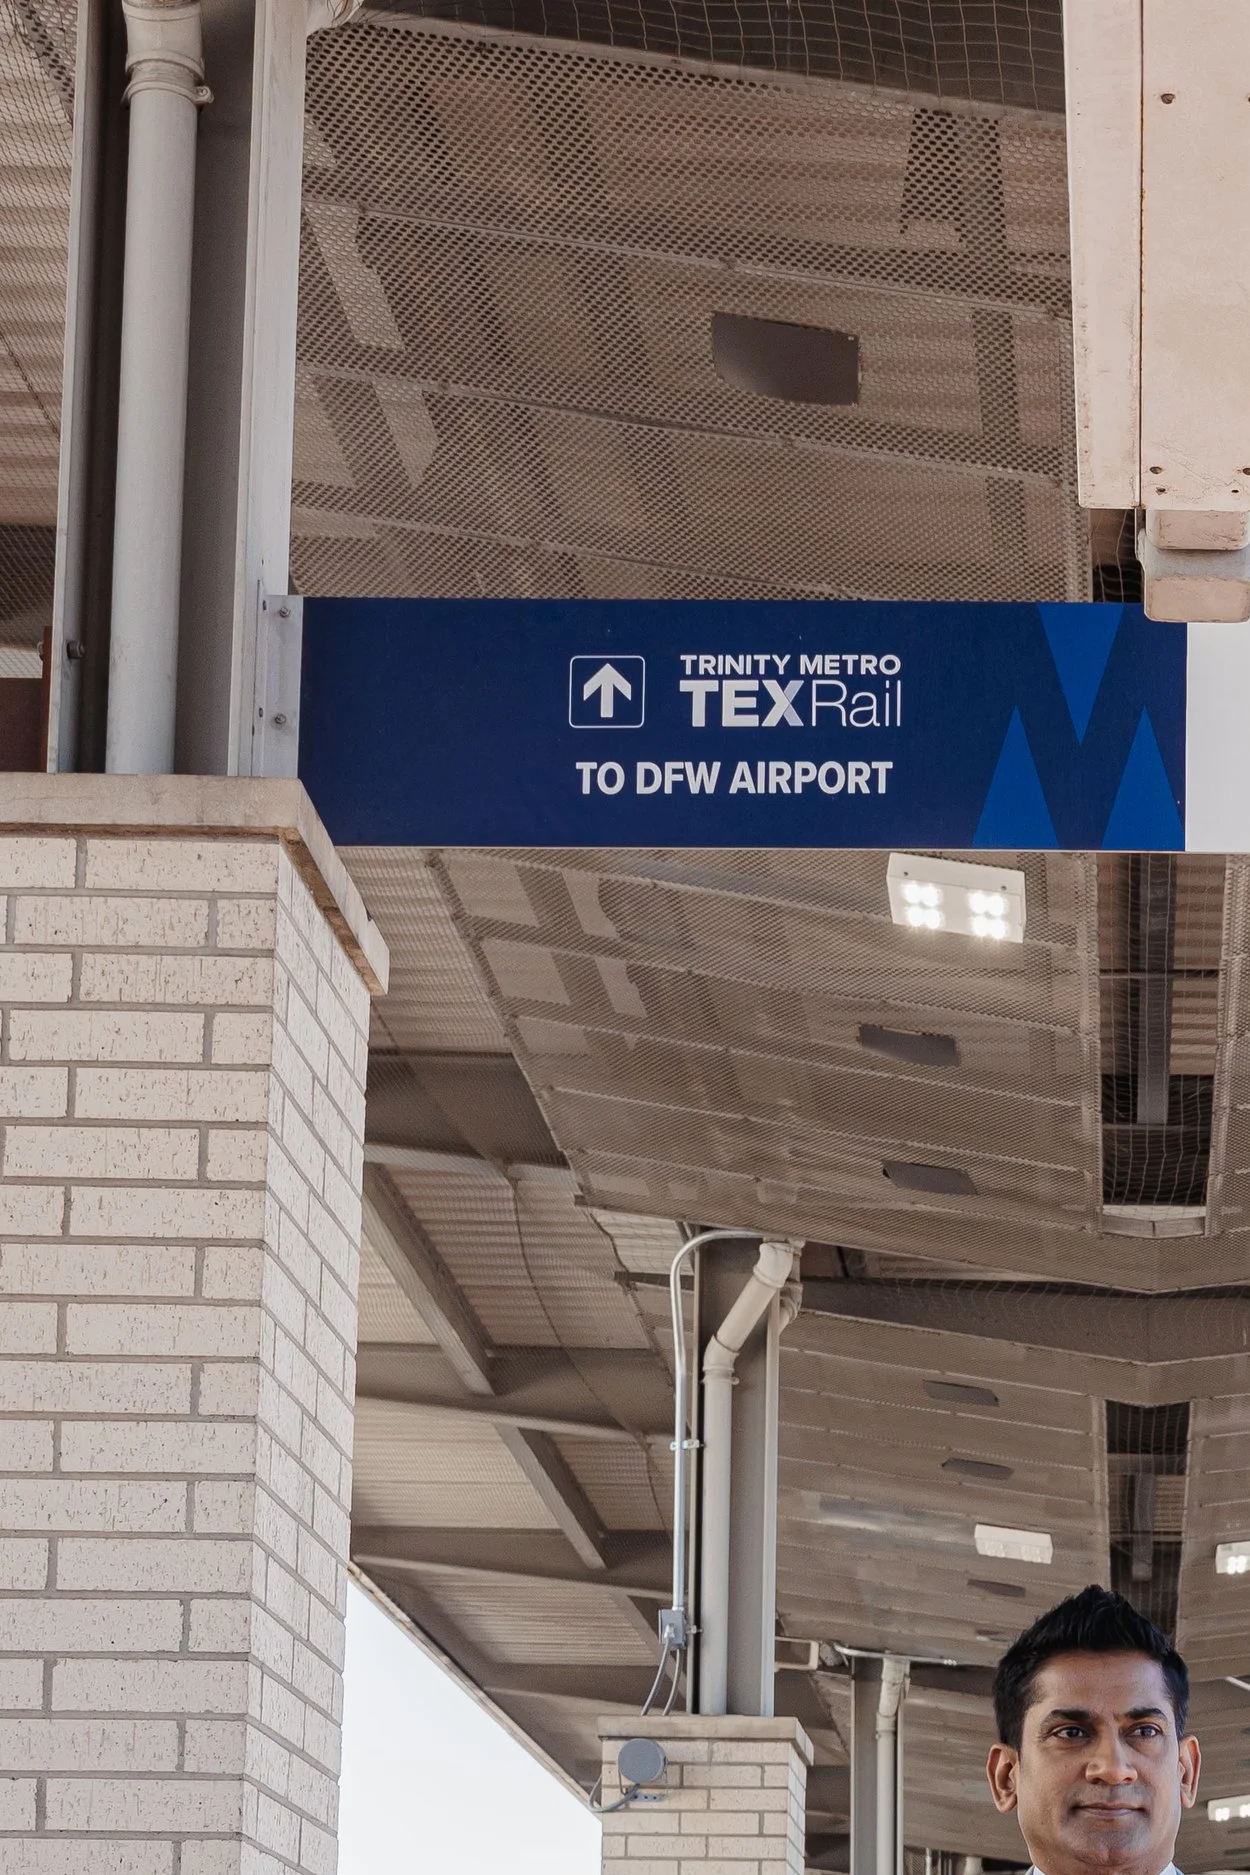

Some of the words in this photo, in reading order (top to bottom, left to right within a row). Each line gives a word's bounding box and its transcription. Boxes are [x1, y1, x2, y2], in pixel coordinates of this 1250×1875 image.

[680, 655, 790, 674] TRINITY
[800, 655, 901, 675] METRO
[576, 762, 624, 794] TO
[637, 762, 721, 794] DFW
[729, 761, 893, 794] AIRPORT
